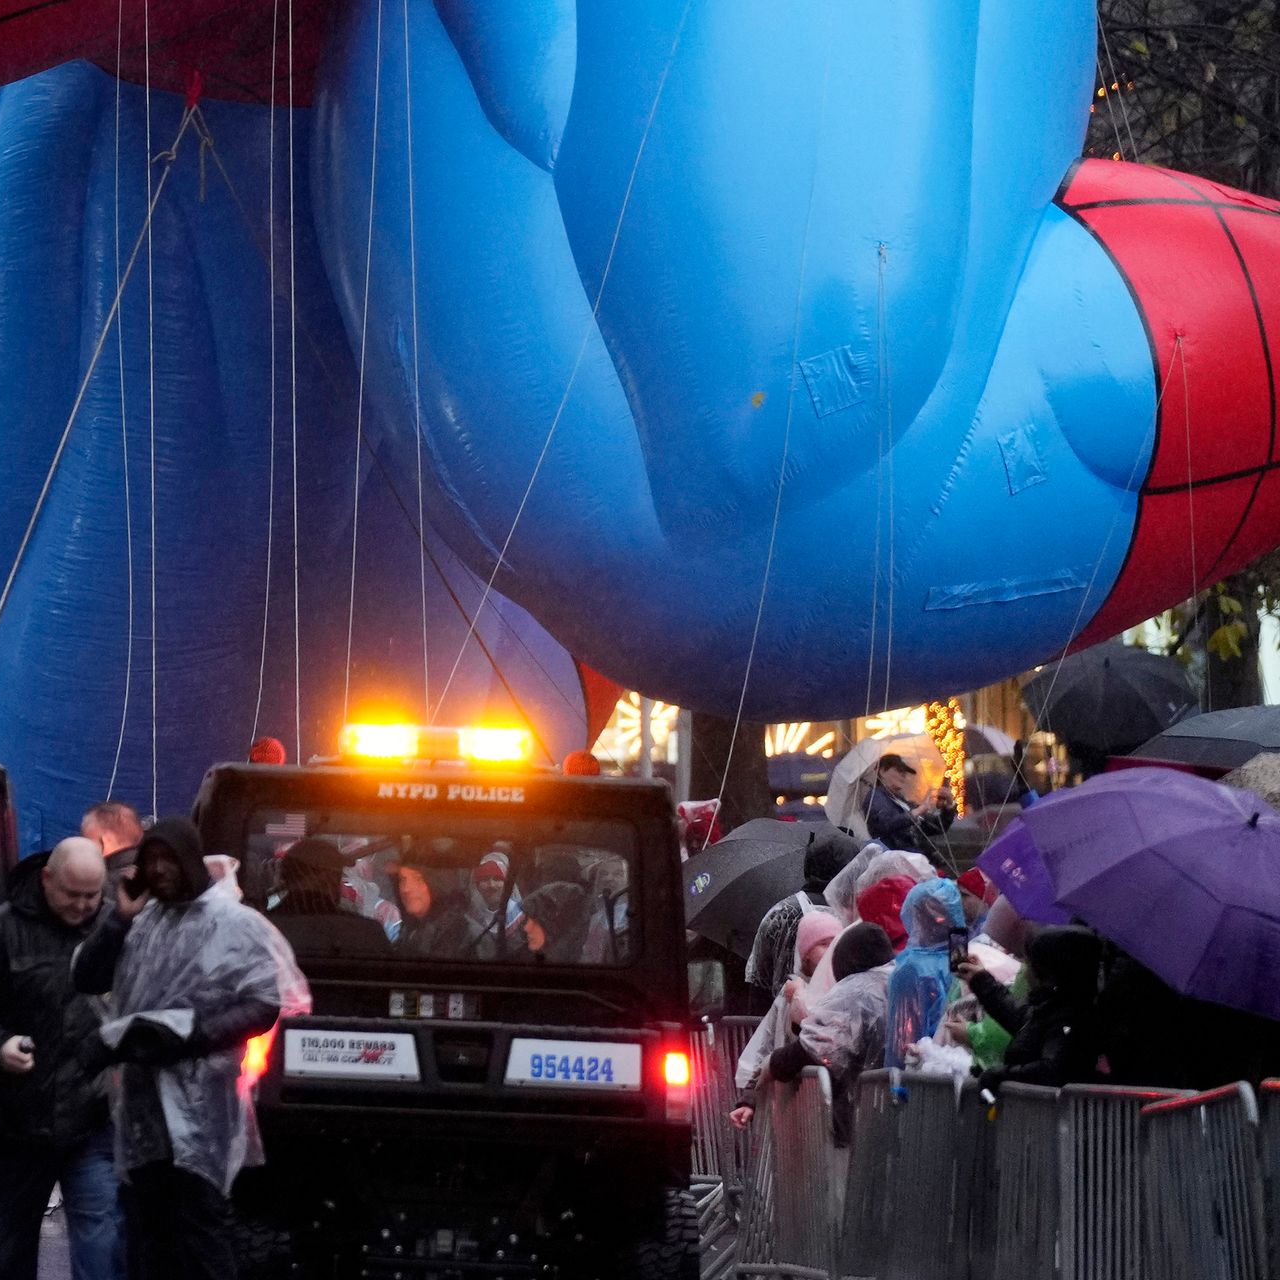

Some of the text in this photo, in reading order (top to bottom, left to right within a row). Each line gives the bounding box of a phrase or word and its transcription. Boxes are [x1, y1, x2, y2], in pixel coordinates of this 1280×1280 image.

[377, 783, 525, 803] NYPD POLICE
[349, 1039, 396, 1051] REWARD
[530, 1053, 614, 1082] 954424
